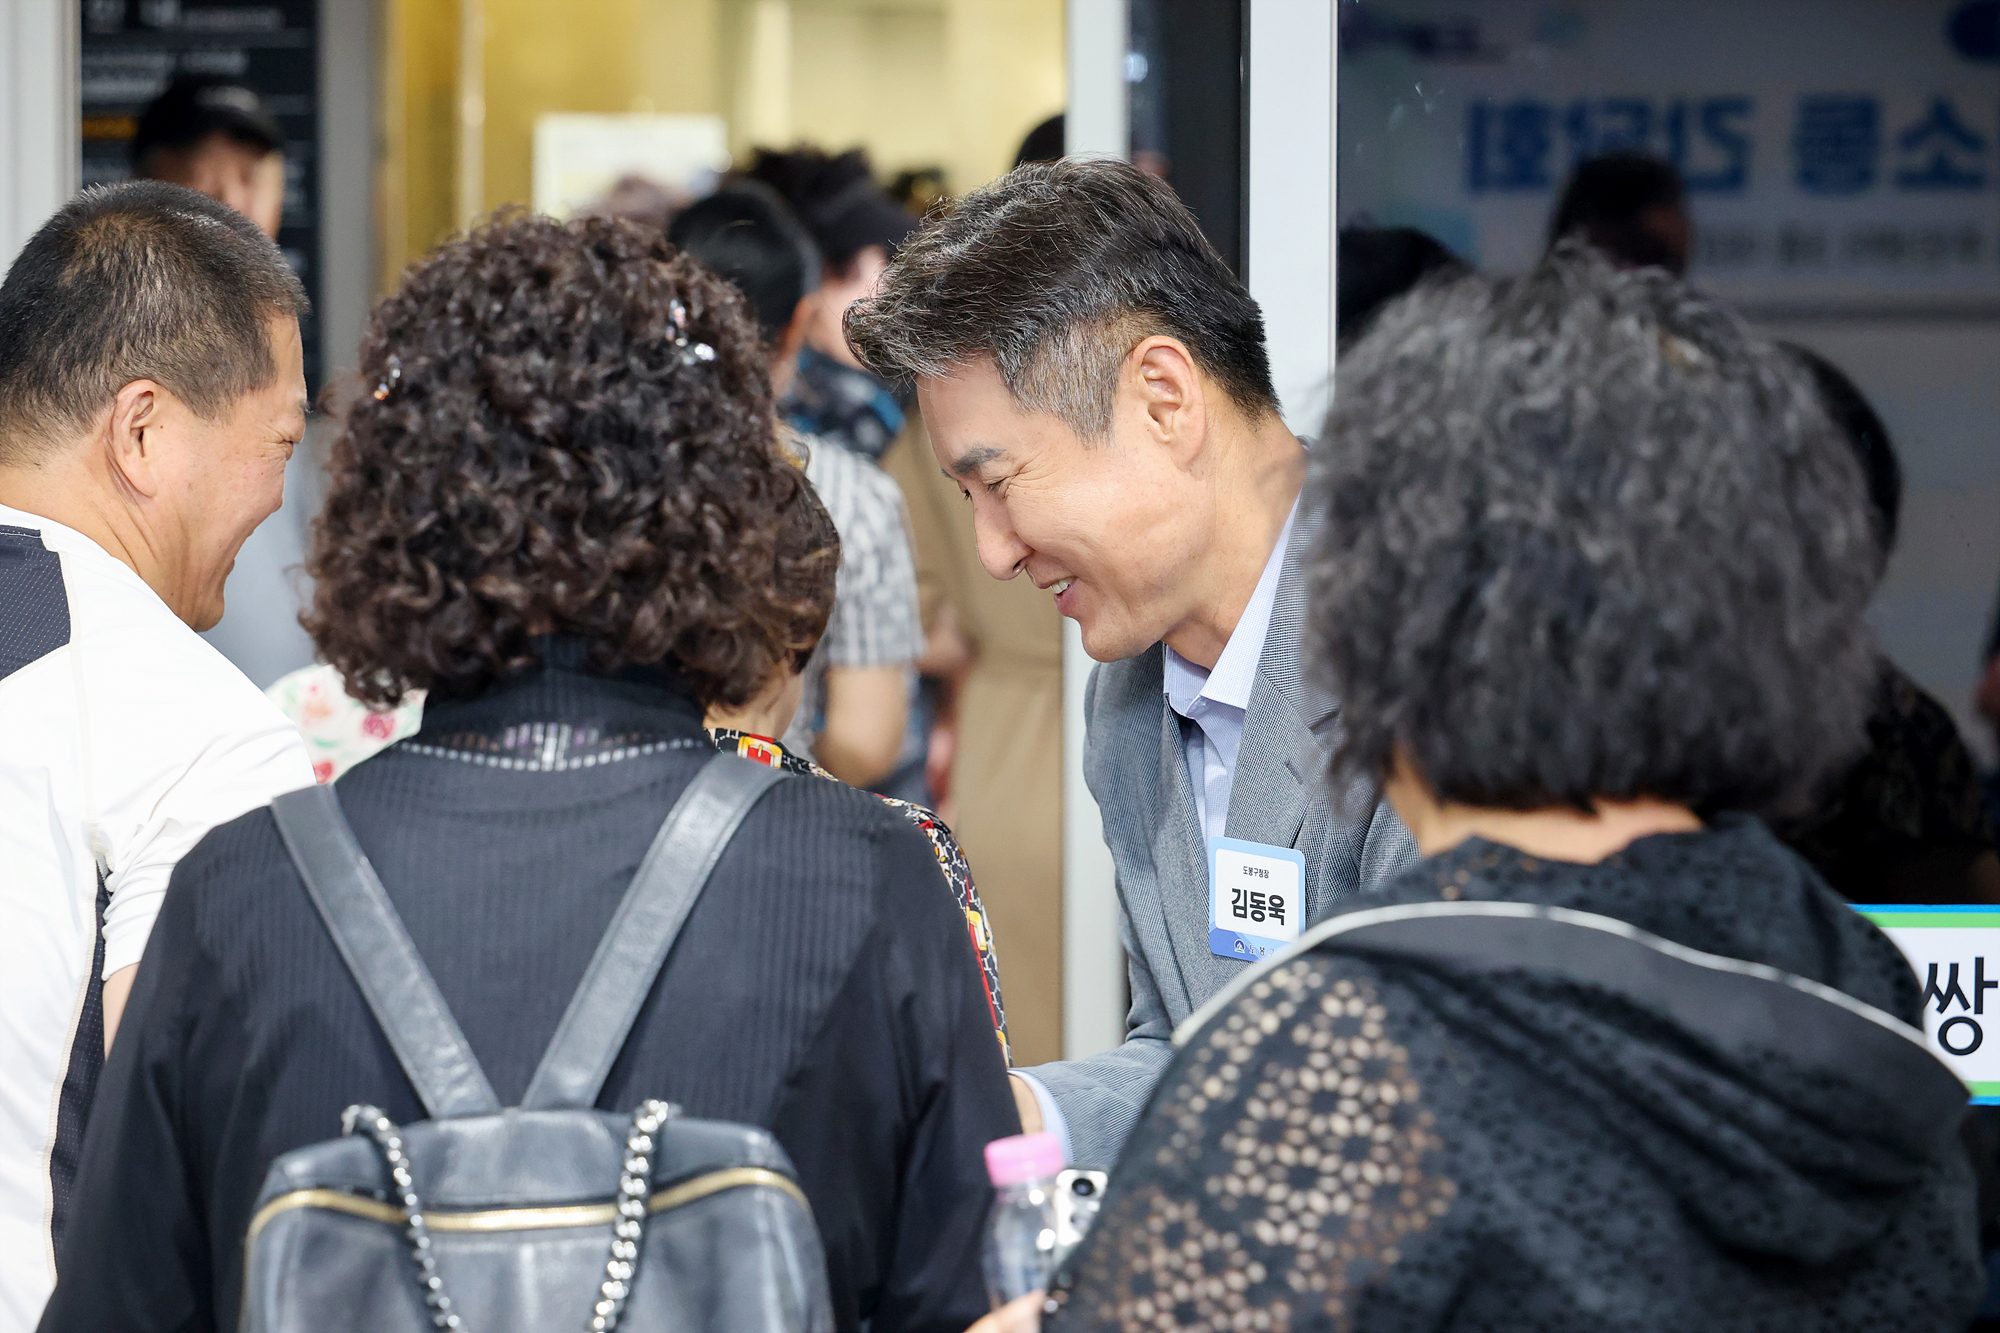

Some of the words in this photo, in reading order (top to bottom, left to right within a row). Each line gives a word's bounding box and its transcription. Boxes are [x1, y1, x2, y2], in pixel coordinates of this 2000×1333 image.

[1242, 865, 1270, 879] 도봉구청장
[1230, 887, 1286, 927] 김동욱
[1923, 956, 1999, 1056] 쌍
